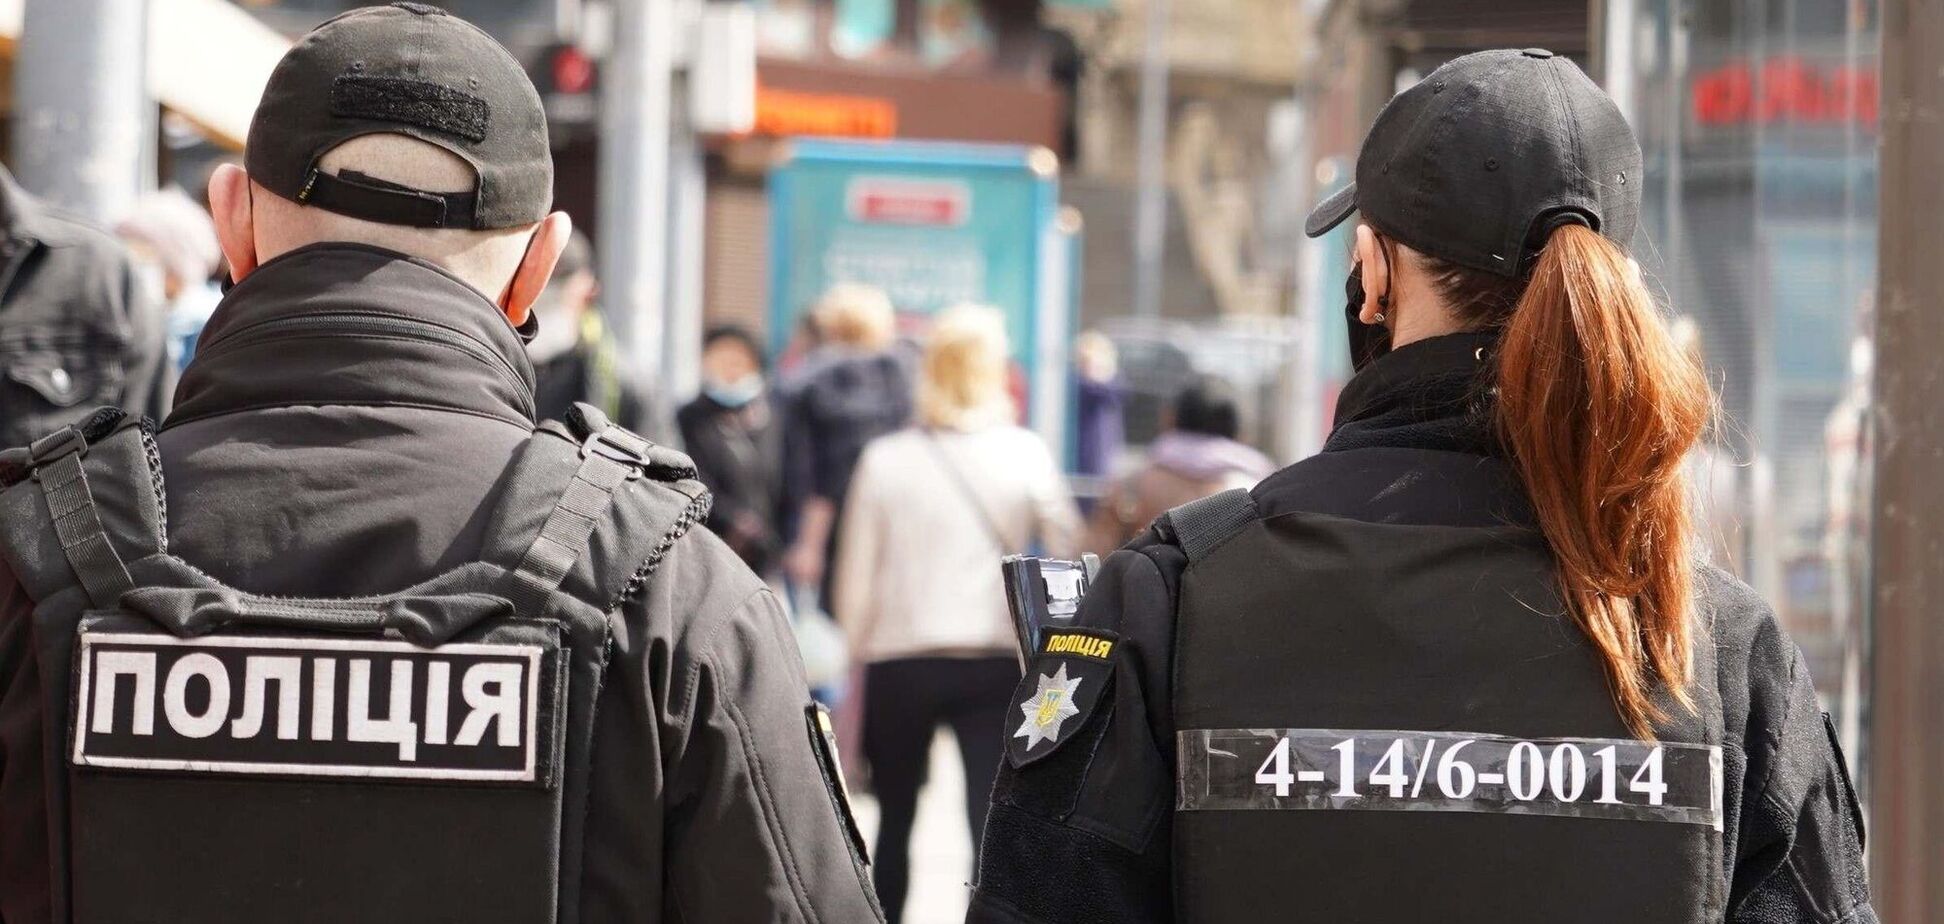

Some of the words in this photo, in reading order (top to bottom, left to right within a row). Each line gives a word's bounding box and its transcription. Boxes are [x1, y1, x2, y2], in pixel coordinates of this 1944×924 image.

[1047, 635, 1112, 658] ПОЛІЦІЯ
[91, 651, 523, 761] ПОЛІЦІЯ
[1255, 737, 1668, 805] 4-14/6-0014
